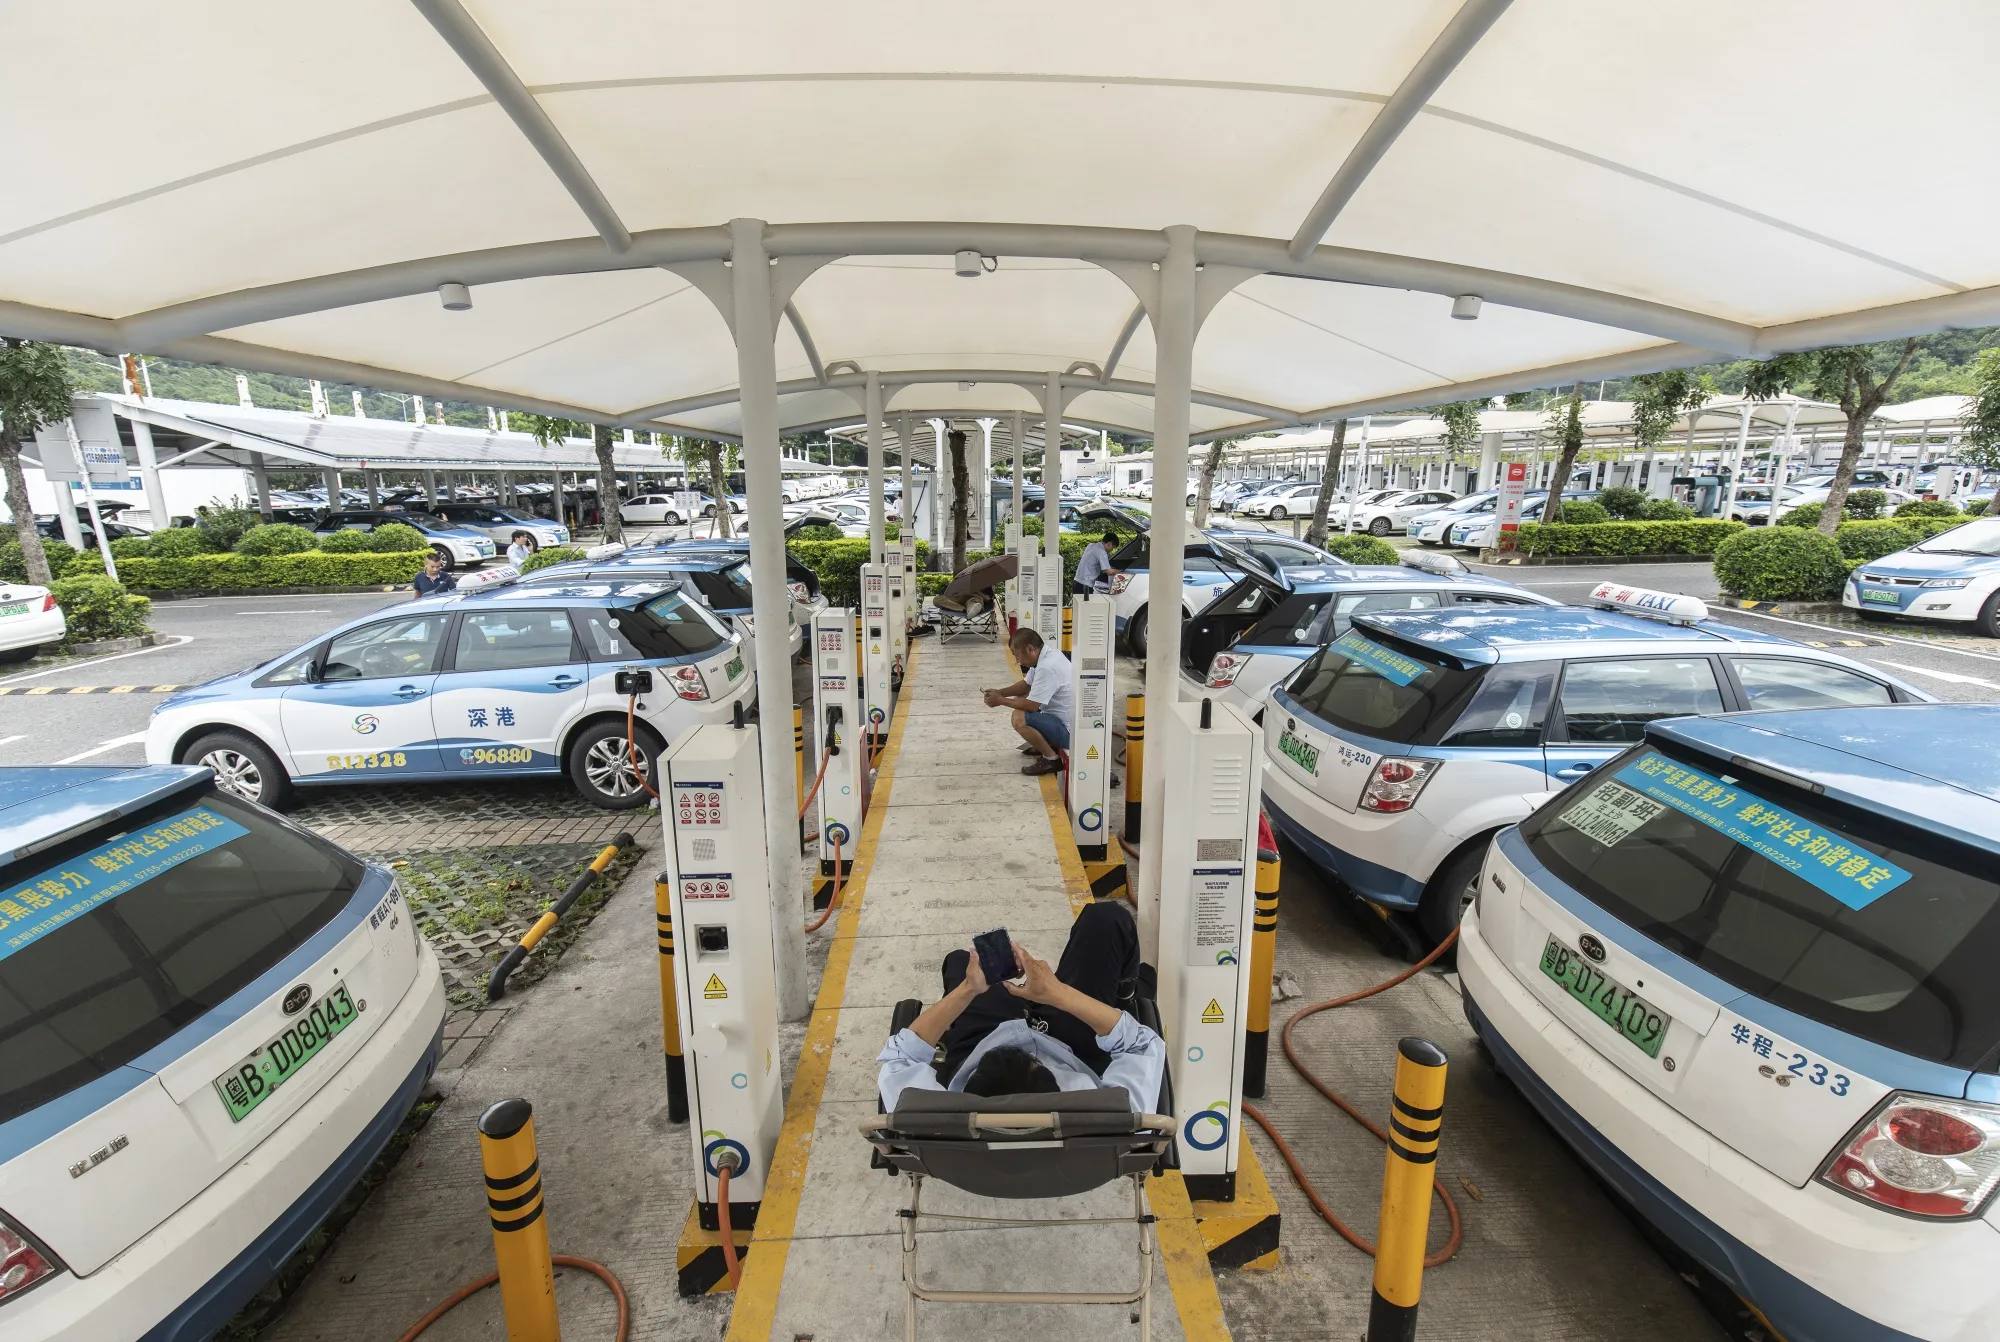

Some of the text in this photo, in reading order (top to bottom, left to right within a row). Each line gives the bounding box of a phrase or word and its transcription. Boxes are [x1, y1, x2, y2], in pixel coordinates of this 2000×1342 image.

[1595, 585, 1678, 611] 深圳 TAXI
[468, 706, 516, 728] 深港
[342, 752, 407, 770] 12328
[474, 748, 532, 764] 96880
[1735, 803, 1893, 890] 维护社会和谐稳定
[0, 811, 225, 932] 黑恶势力 维护社会和谐稳定
[1582, 938, 1604, 962] BYD
[286, 988, 309, 1015] BYD
[1730, 1022, 1851, 1098] 华程-233
